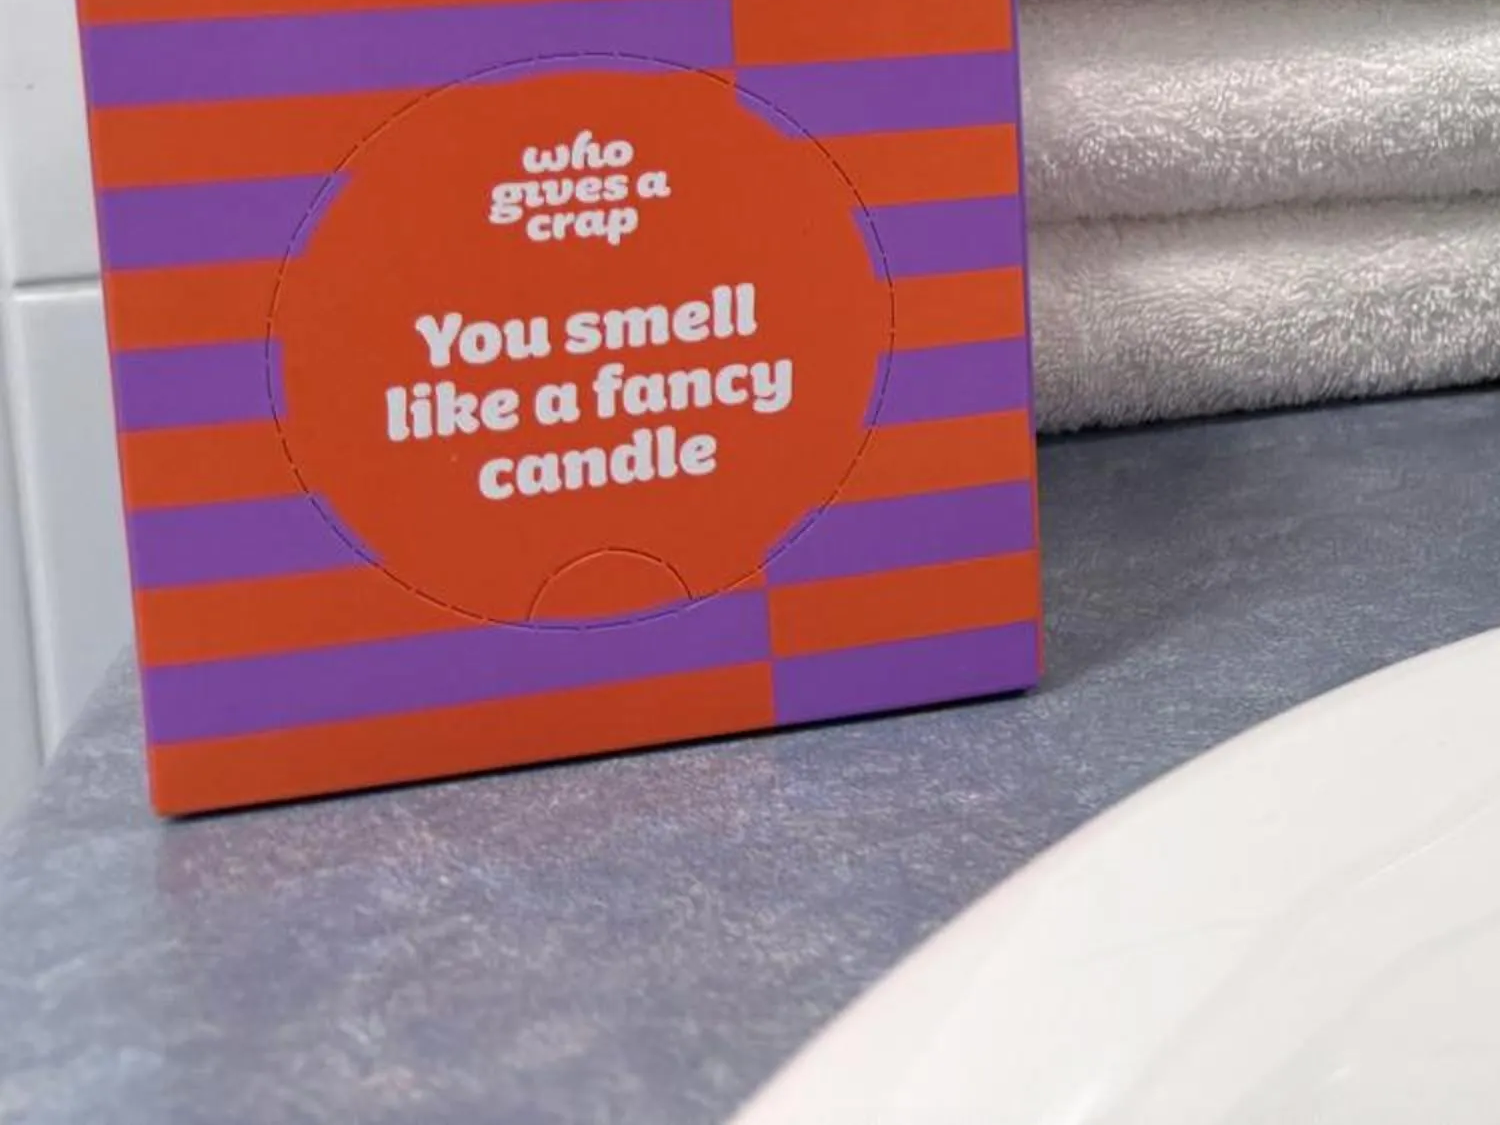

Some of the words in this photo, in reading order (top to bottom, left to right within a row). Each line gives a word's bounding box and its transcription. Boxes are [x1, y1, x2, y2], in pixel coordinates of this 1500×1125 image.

[521, 130, 634, 174] who
[488, 173, 629, 225] gives
[635, 170, 671, 199] a
[525, 206, 639, 246] crap
[414, 312, 552, 368] You
[564, 282, 758, 355] smell
[385, 380, 520, 442] like
[533, 382, 581, 426] a
[592, 358, 793, 414] fancy
[478, 425, 717, 500] candle
